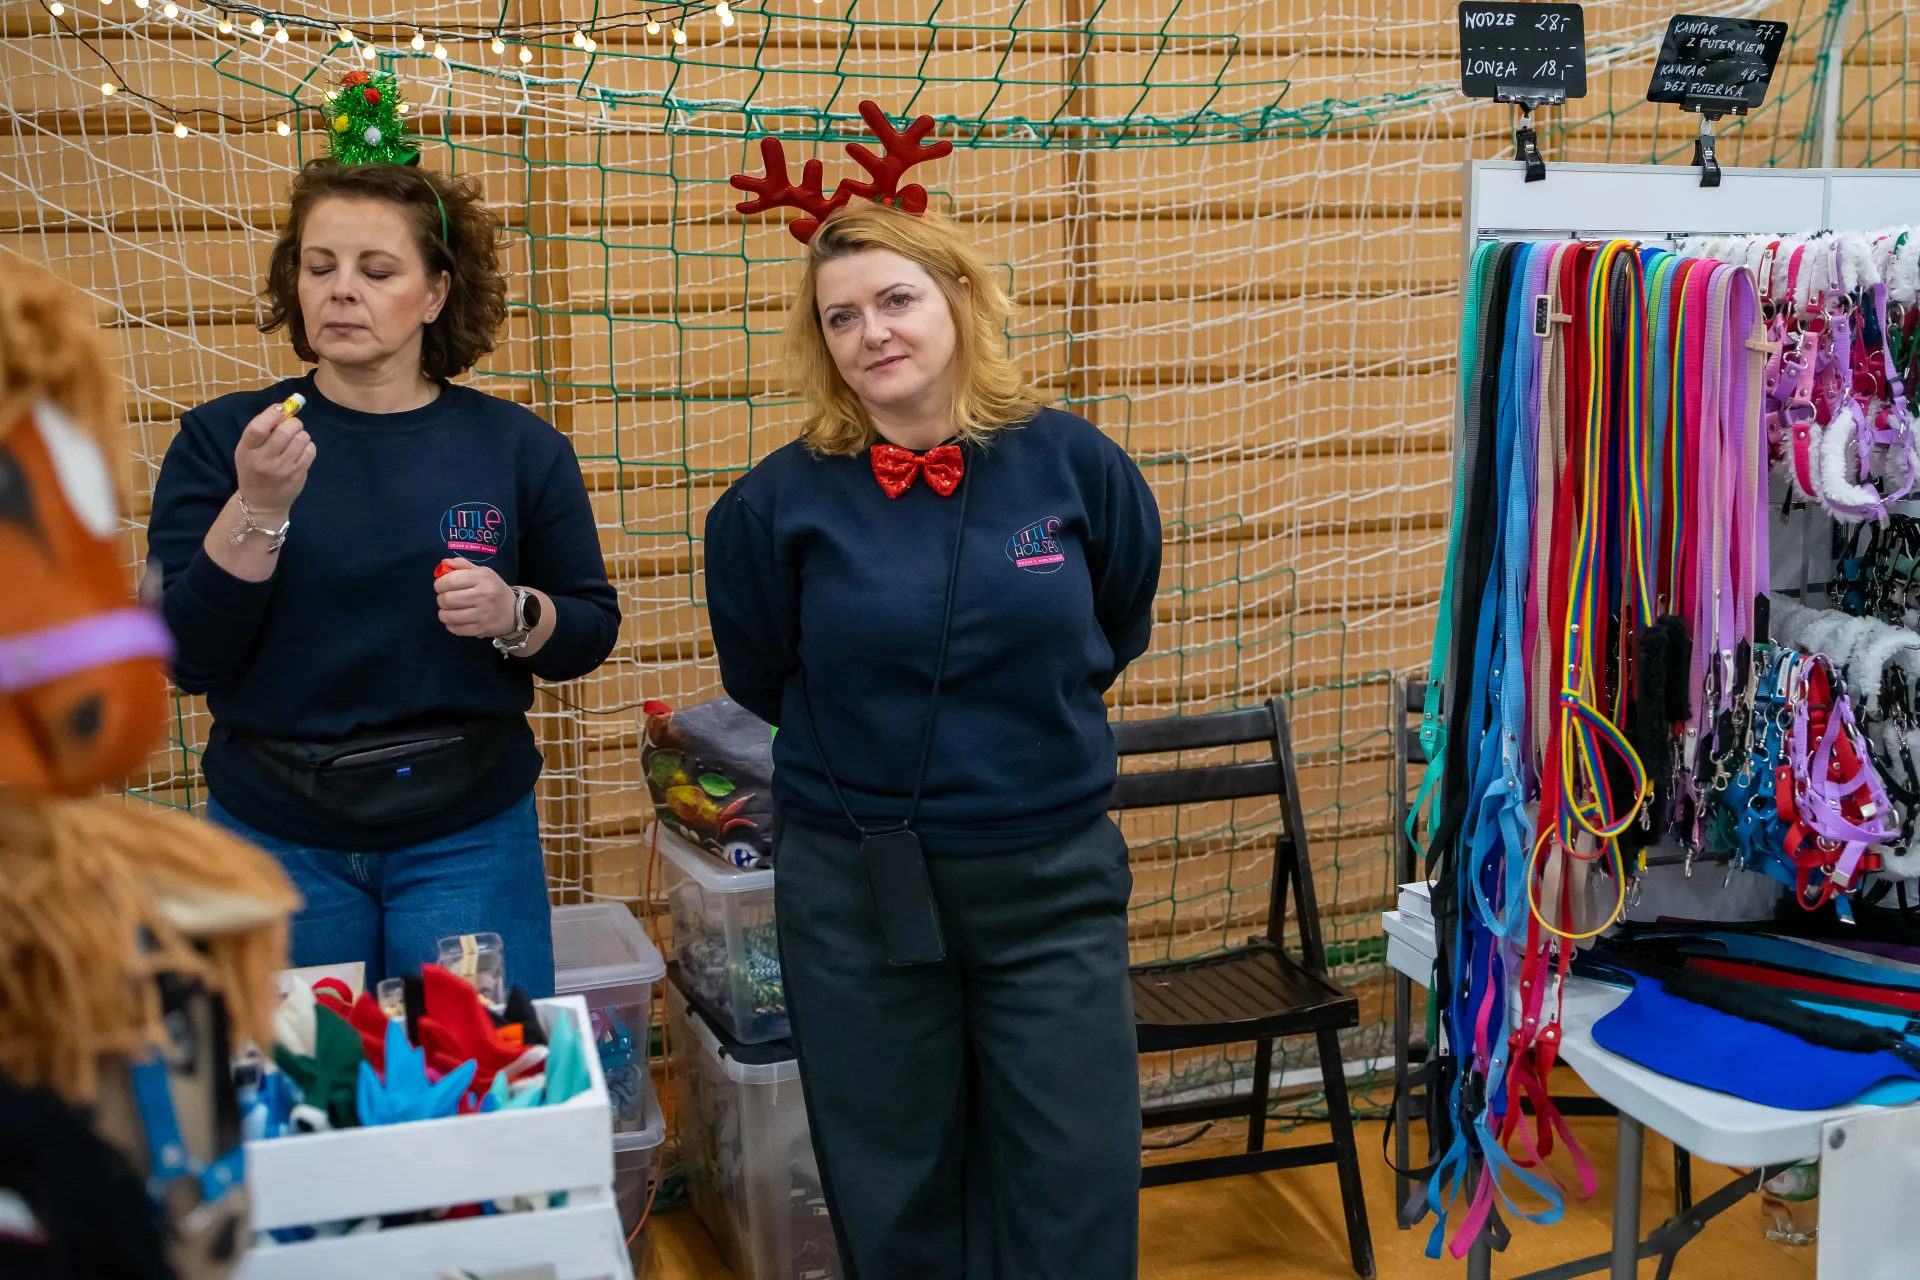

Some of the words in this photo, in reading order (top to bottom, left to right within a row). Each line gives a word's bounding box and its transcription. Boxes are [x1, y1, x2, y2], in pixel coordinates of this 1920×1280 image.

[1465, 11, 1516, 29] WODZE
[1674, 22, 1719, 36] KANTAR
[1686, 37, 1696, 47] Z
[1699, 38, 1765, 55] FUTERKIEM
[1660, 64, 1707, 77] KANTAR
[1690, 82, 1744, 97] FUTERKA
